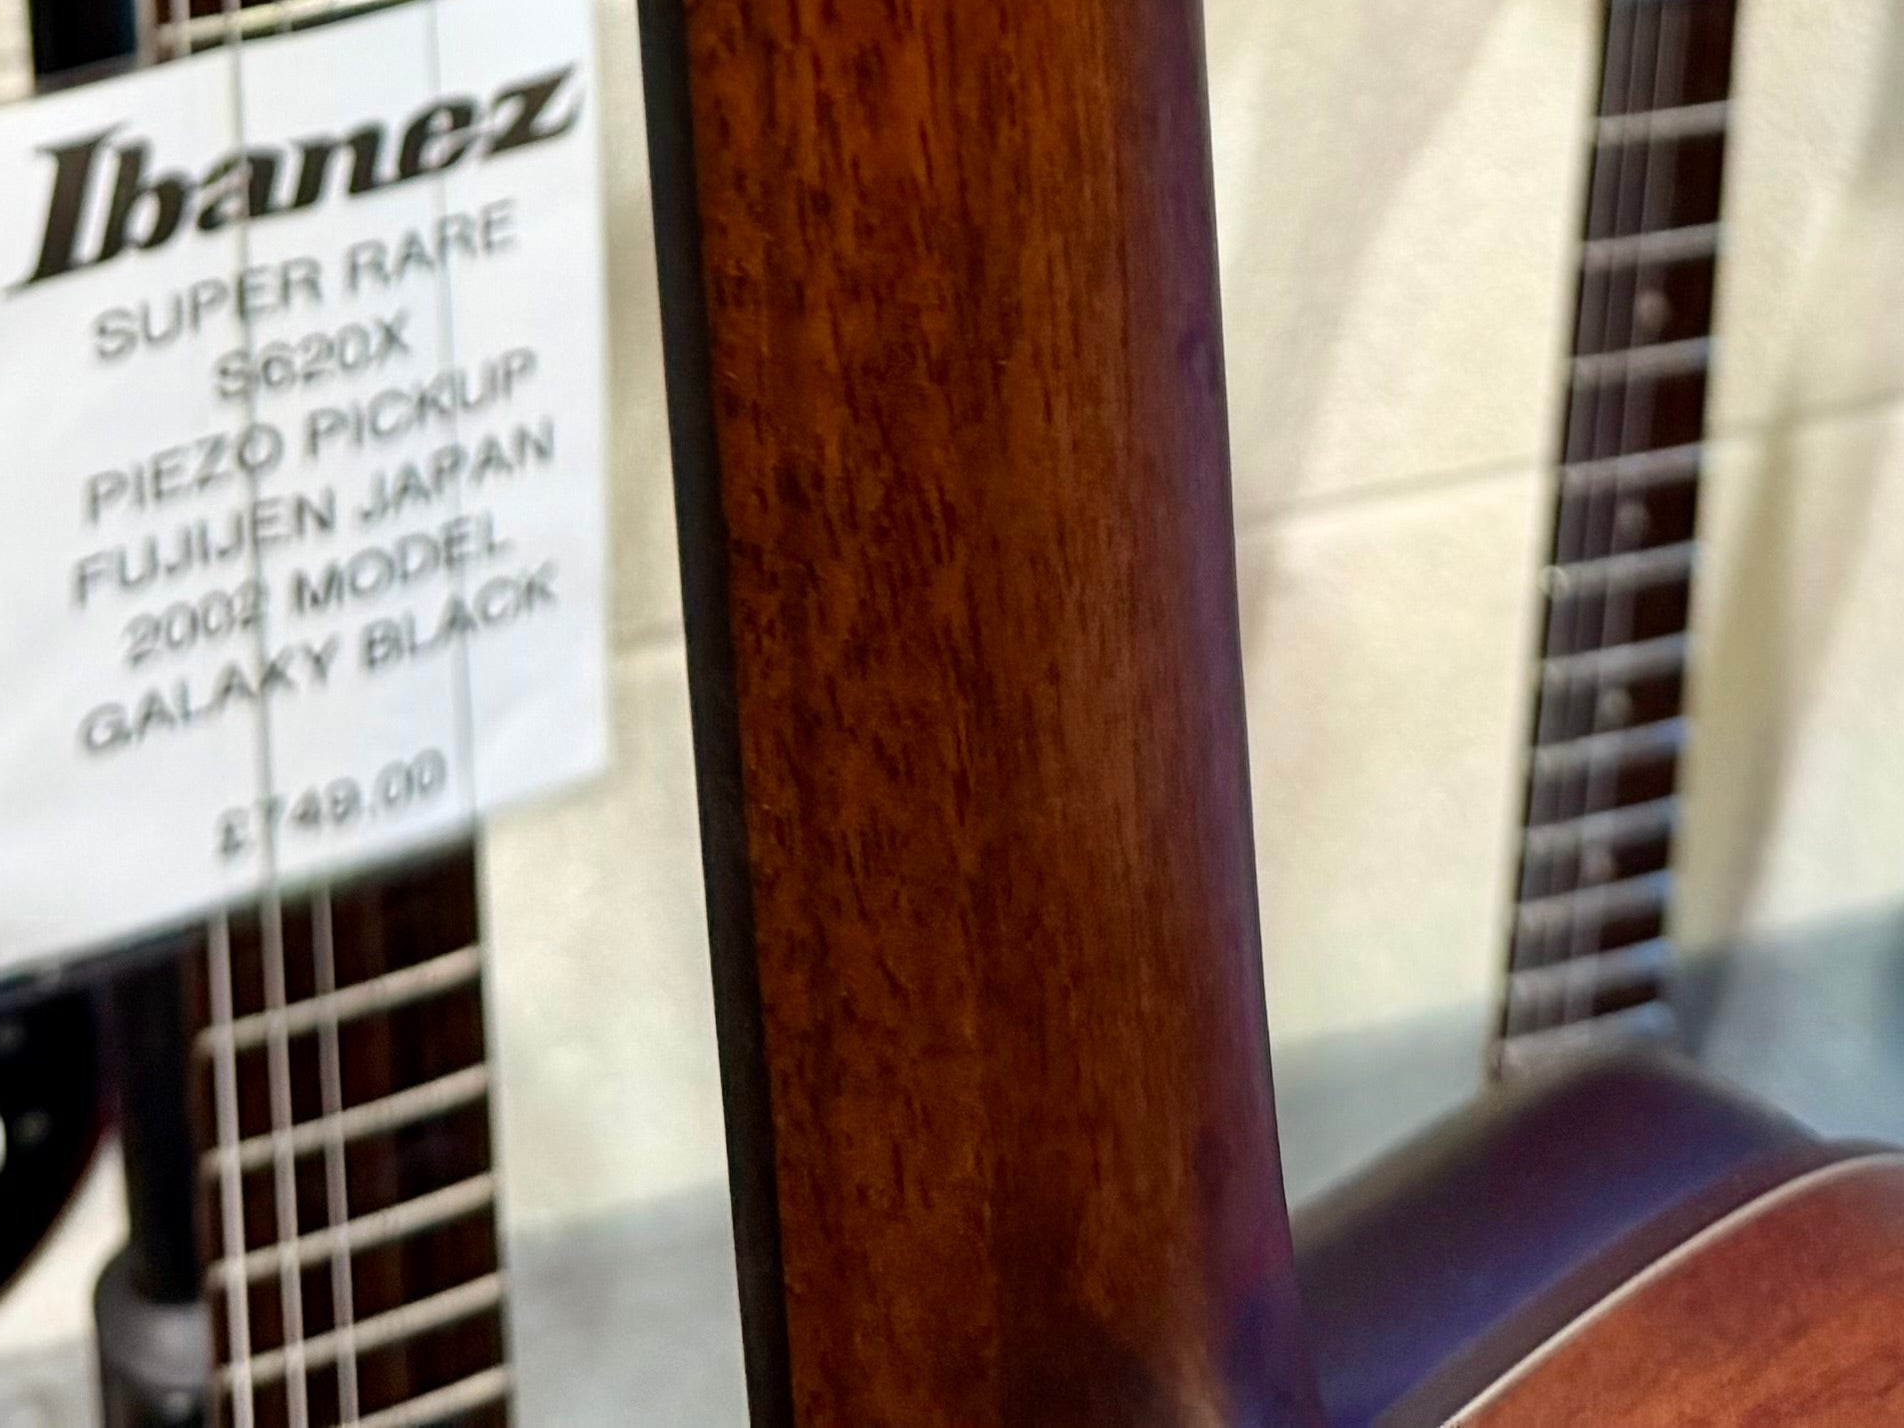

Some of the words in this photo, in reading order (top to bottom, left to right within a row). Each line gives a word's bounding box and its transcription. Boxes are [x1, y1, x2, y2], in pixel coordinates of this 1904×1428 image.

[1, 61, 585, 296] Ibanez
[91, 256, 325, 363] SUPER
[345, 198, 520, 296] RARE
[212, 310, 412, 403] S620X
[83, 423, 284, 525] PIEZO
[304, 346, 538, 457] PICKUP
[358, 418, 556, 525] JAPAN
[77, 633, 339, 754] GALAXY
[360, 559, 559, 673] BLACK
[122, 578, 270, 668] 2002
[289, 509, 516, 616] MODEL
